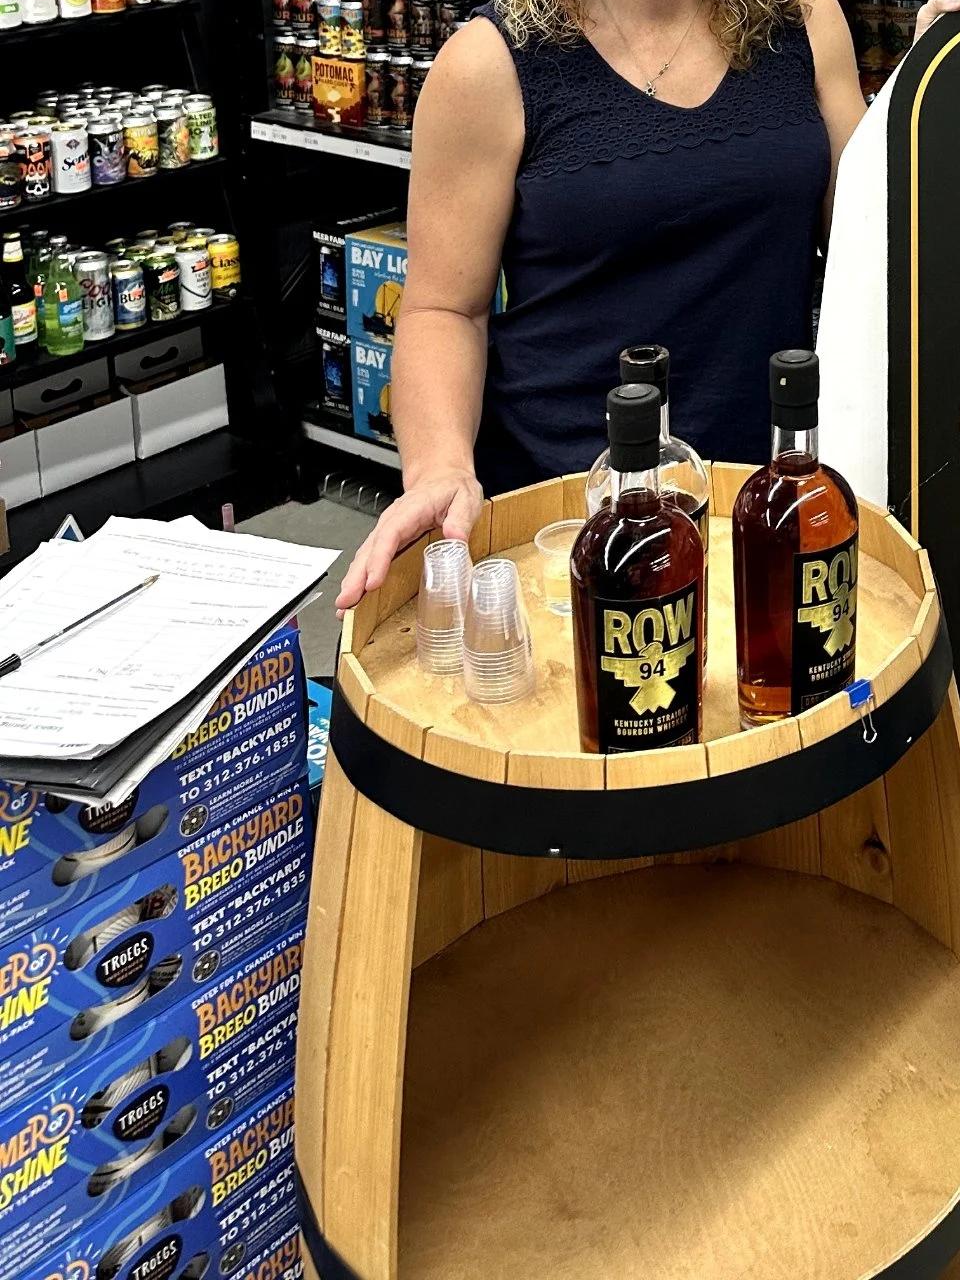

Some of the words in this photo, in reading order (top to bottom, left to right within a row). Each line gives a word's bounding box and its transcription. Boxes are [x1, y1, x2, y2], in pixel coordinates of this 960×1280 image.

[314, 62, 354, 82] POTOMAC
[355, 346, 386, 370] BAY
[603, 591, 695, 655] ROW
[832, 598, 849, 621] 94
[639, 662, 666, 680] 94
[614, 718, 654, 728] KENTUCKY
[656, 705, 689, 724] STRAIGHT
[617, 726, 655, 736] BOURBON
[657, 715, 687, 734] WHISKEY
[179, 788, 200, 804] TO
[204, 732, 296, 791] 312.376.1835
[10, 793, 28, 812] OF
[178, 838, 206, 858] ENTER
[207, 826, 222, 839] FOR
[223, 822, 230, 831] A
[232, 802, 264, 825] CHANCE
[265, 797, 276, 807] TO
[277, 788, 291, 802] WIN
[293, 782, 300, 790] A
[182, 794, 303, 883] BACKYARD
[185, 858, 244, 910] BREEO
[244, 817, 304, 868] BUNDLE
[193, 934, 213, 950] TO
[216, 872, 306, 940] 312.376.1835
[101, 937, 148, 977] TROEGS
[212, 1149, 268, 1207] BREEO
[219, 1199, 251, 1229] TEXT
